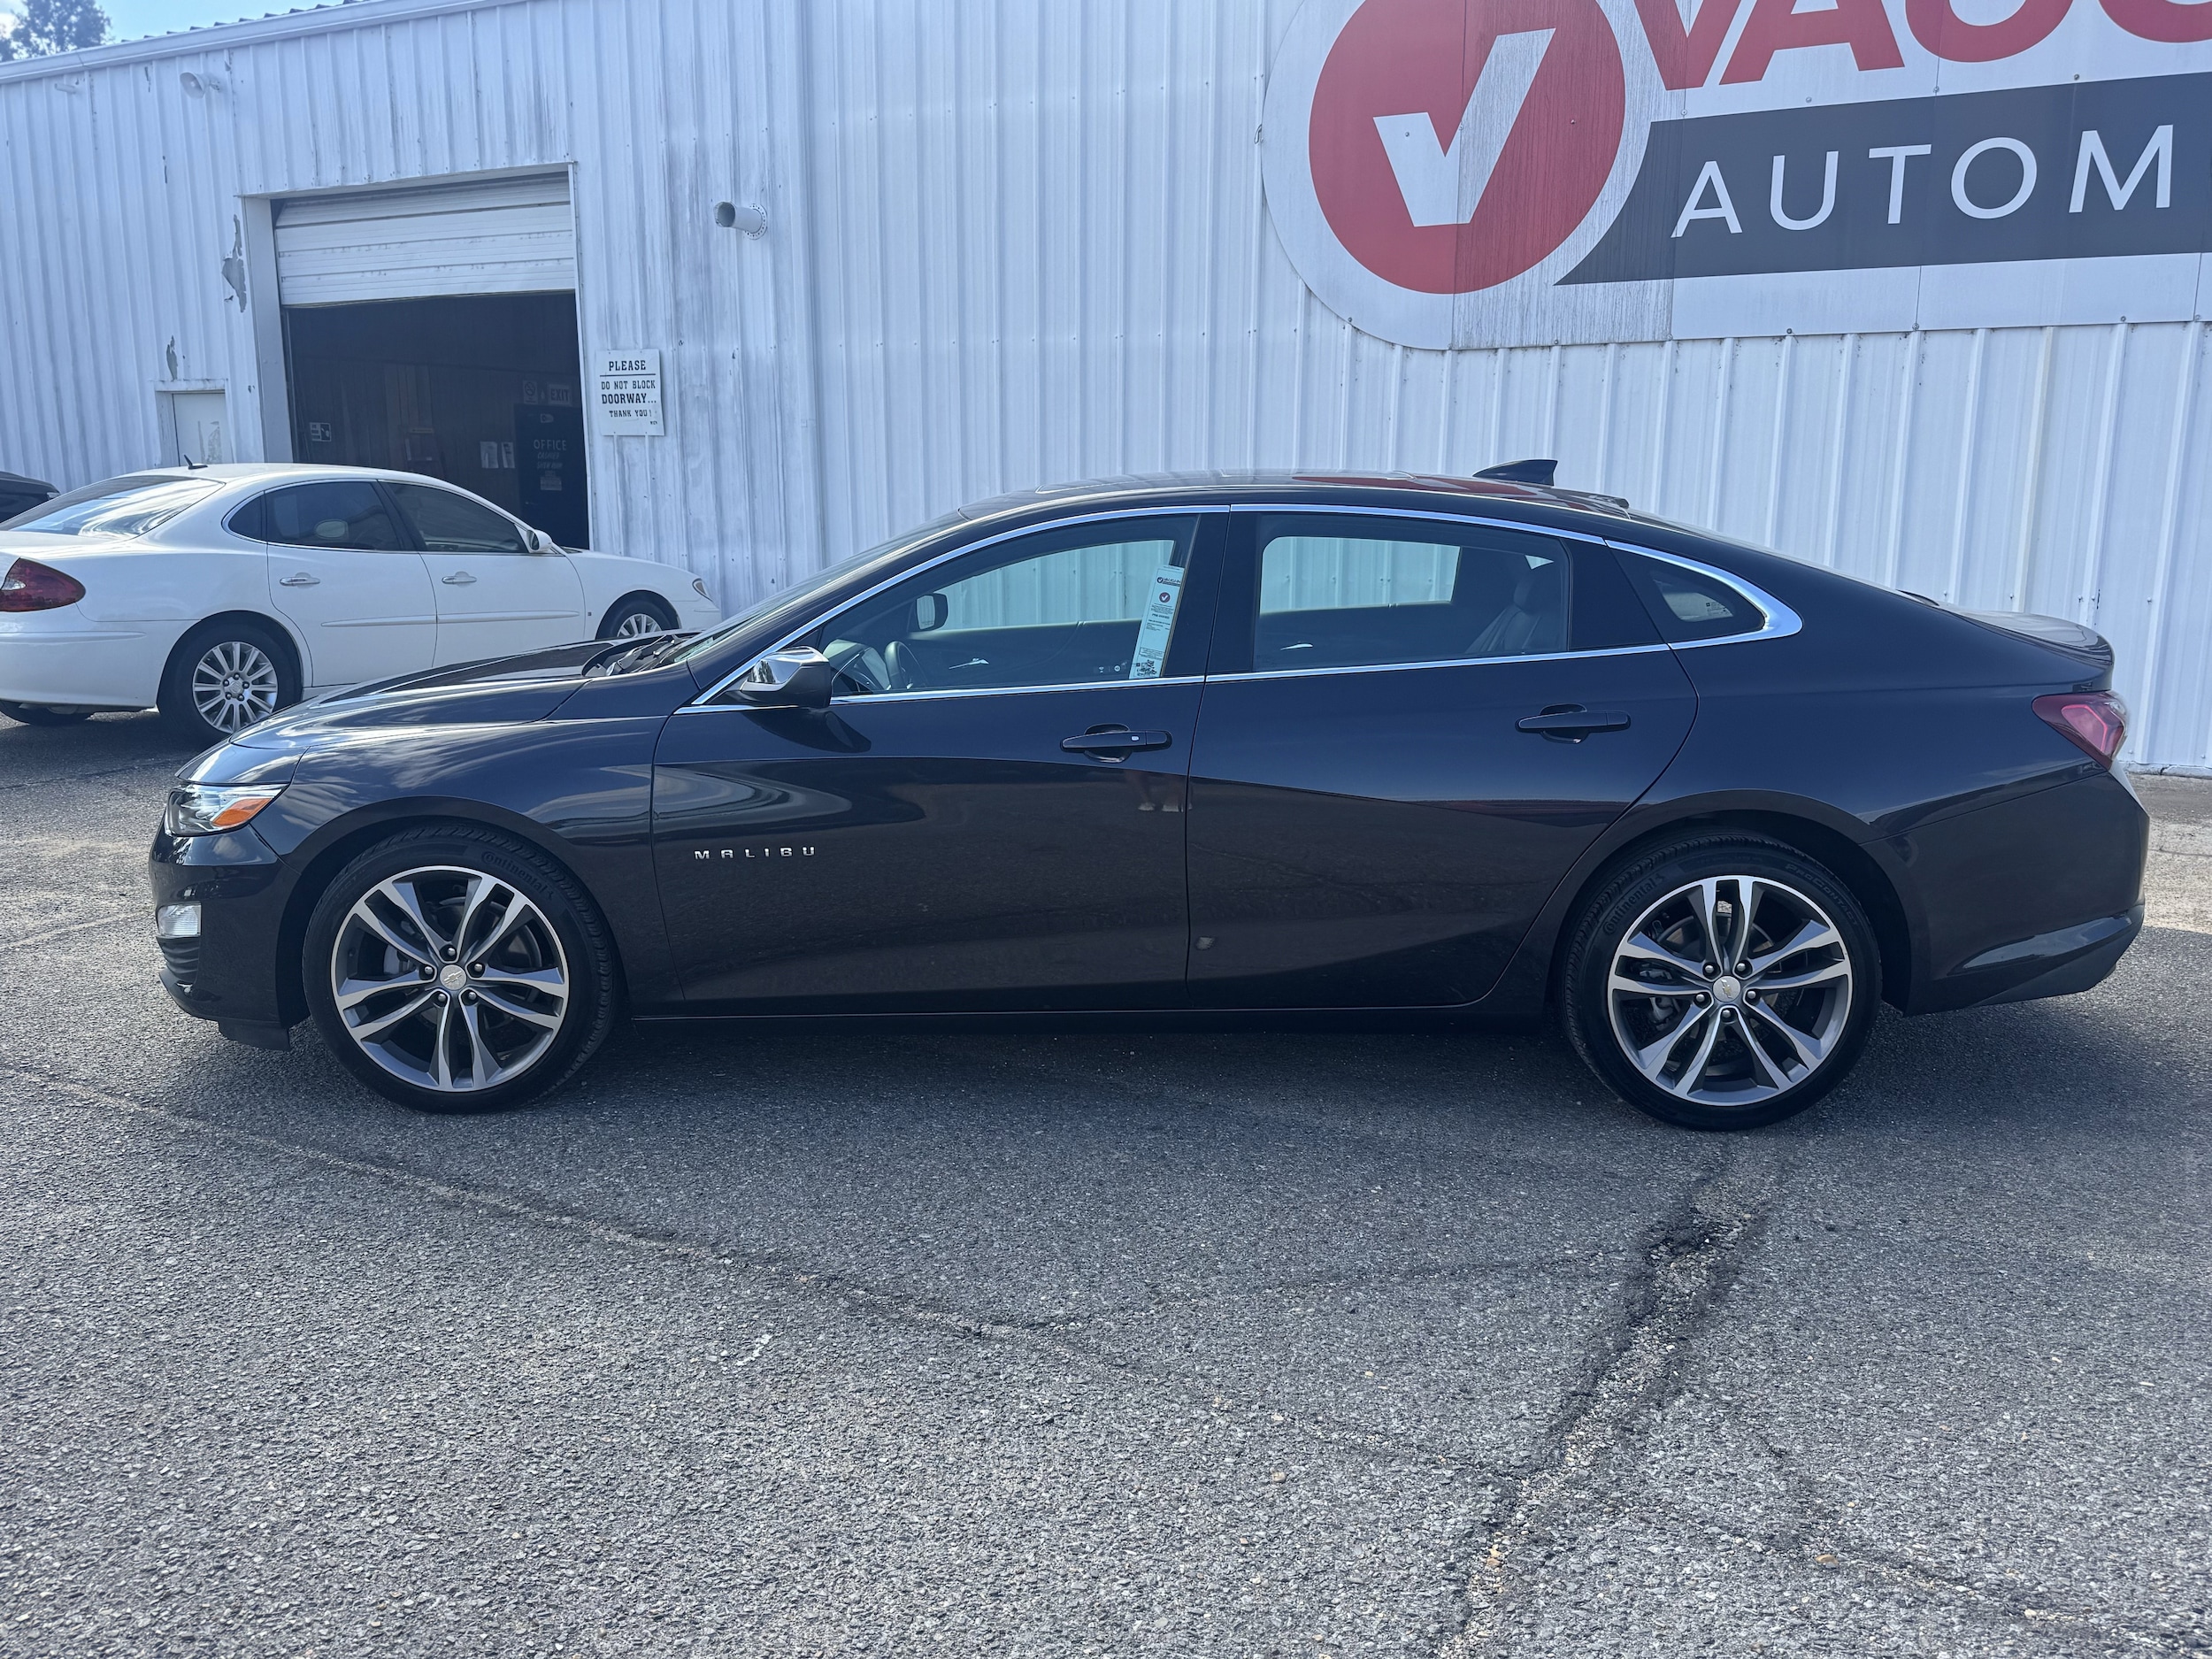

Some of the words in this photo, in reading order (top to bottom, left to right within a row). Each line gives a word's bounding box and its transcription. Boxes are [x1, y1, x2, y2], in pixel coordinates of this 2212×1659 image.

[1633, 0, 2212, 91] VA
[1671, 125, 2173, 238] AUTOM
[609, 360, 646, 371] PLEASE
[614, 380, 628, 389] NOT
[632, 380, 656, 389] BLOCK
[550, 389, 568, 402] EXIT
[601, 393, 657, 403] DOORWAY...
[533, 439, 566, 451] OFFICE
[694, 846, 815, 860] MALIBU
[480, 850, 549, 894] Continental
[1602, 877, 1657, 935] Continental
